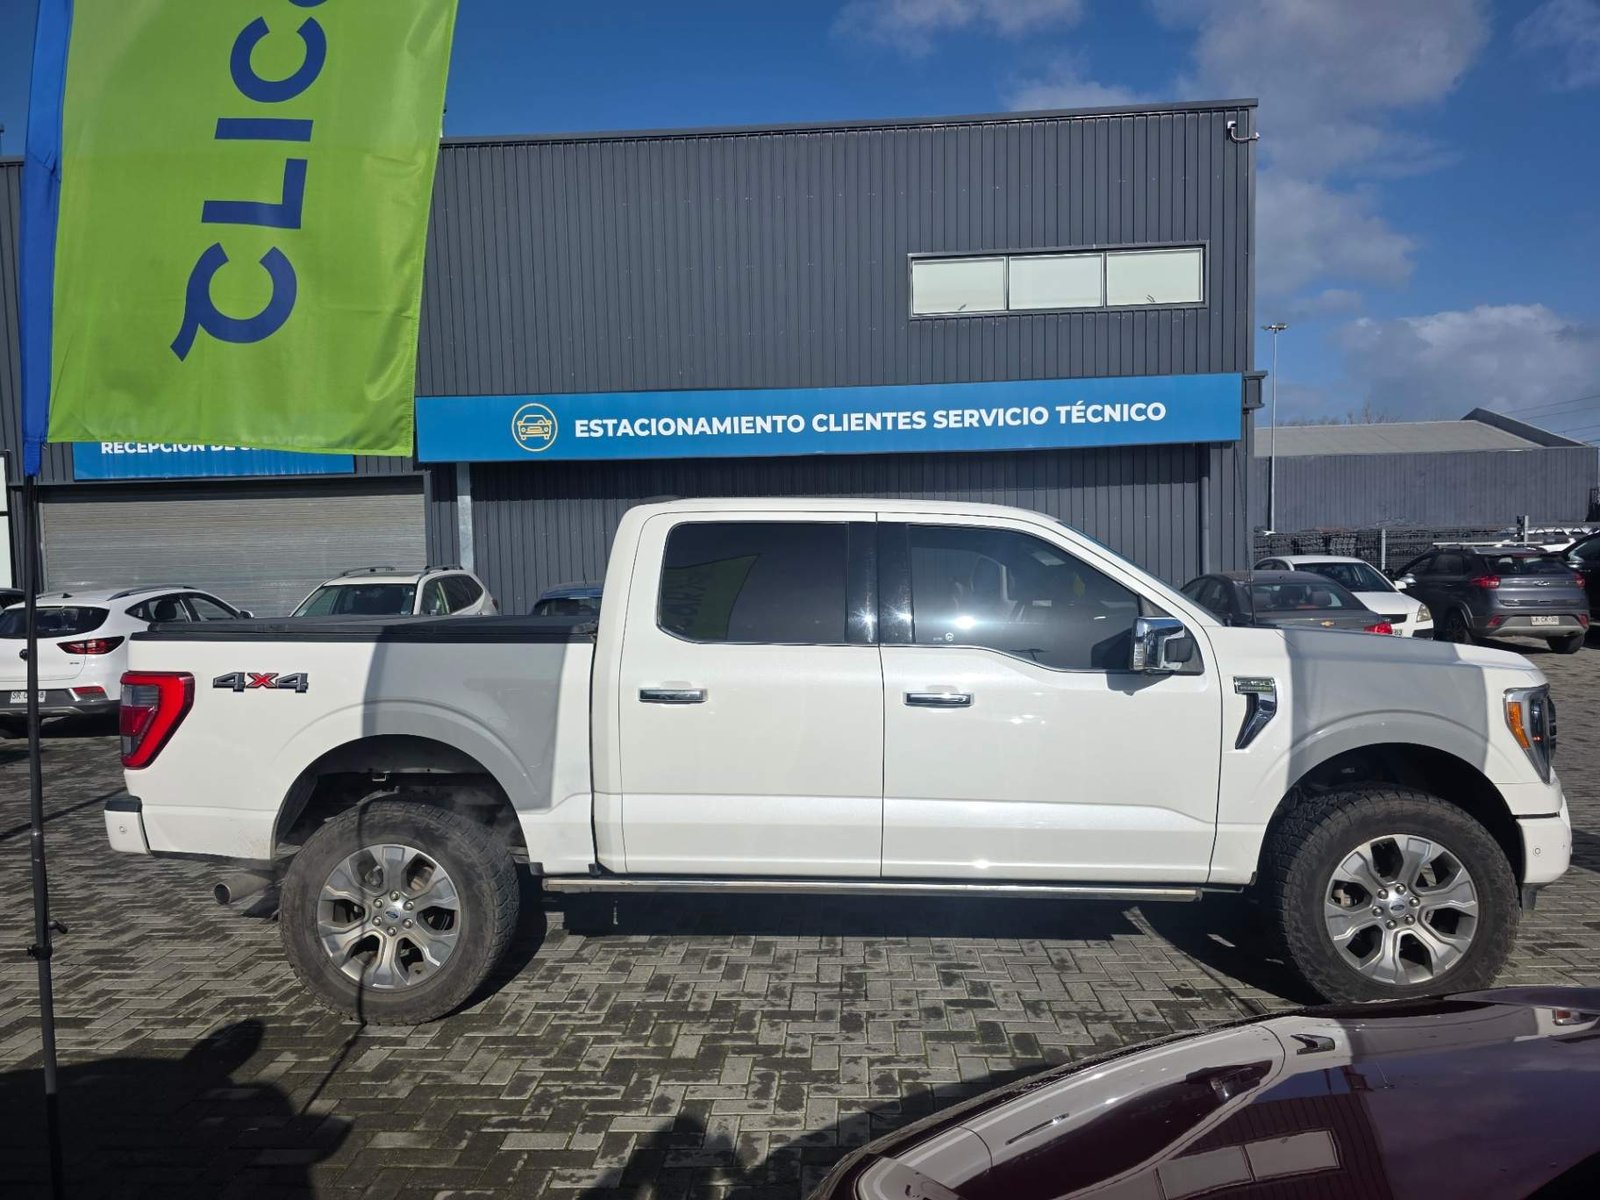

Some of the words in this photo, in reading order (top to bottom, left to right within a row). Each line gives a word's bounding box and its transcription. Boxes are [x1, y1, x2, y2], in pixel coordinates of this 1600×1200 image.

[170, 0, 328, 362] CLIC
[575, 414, 805, 438] ESTACIONAMIENTO
[811, 410, 927, 433] CLIENTES
[932, 406, 1049, 429] SERVICIO
[1055, 400, 1167, 425] TÉCNICO
